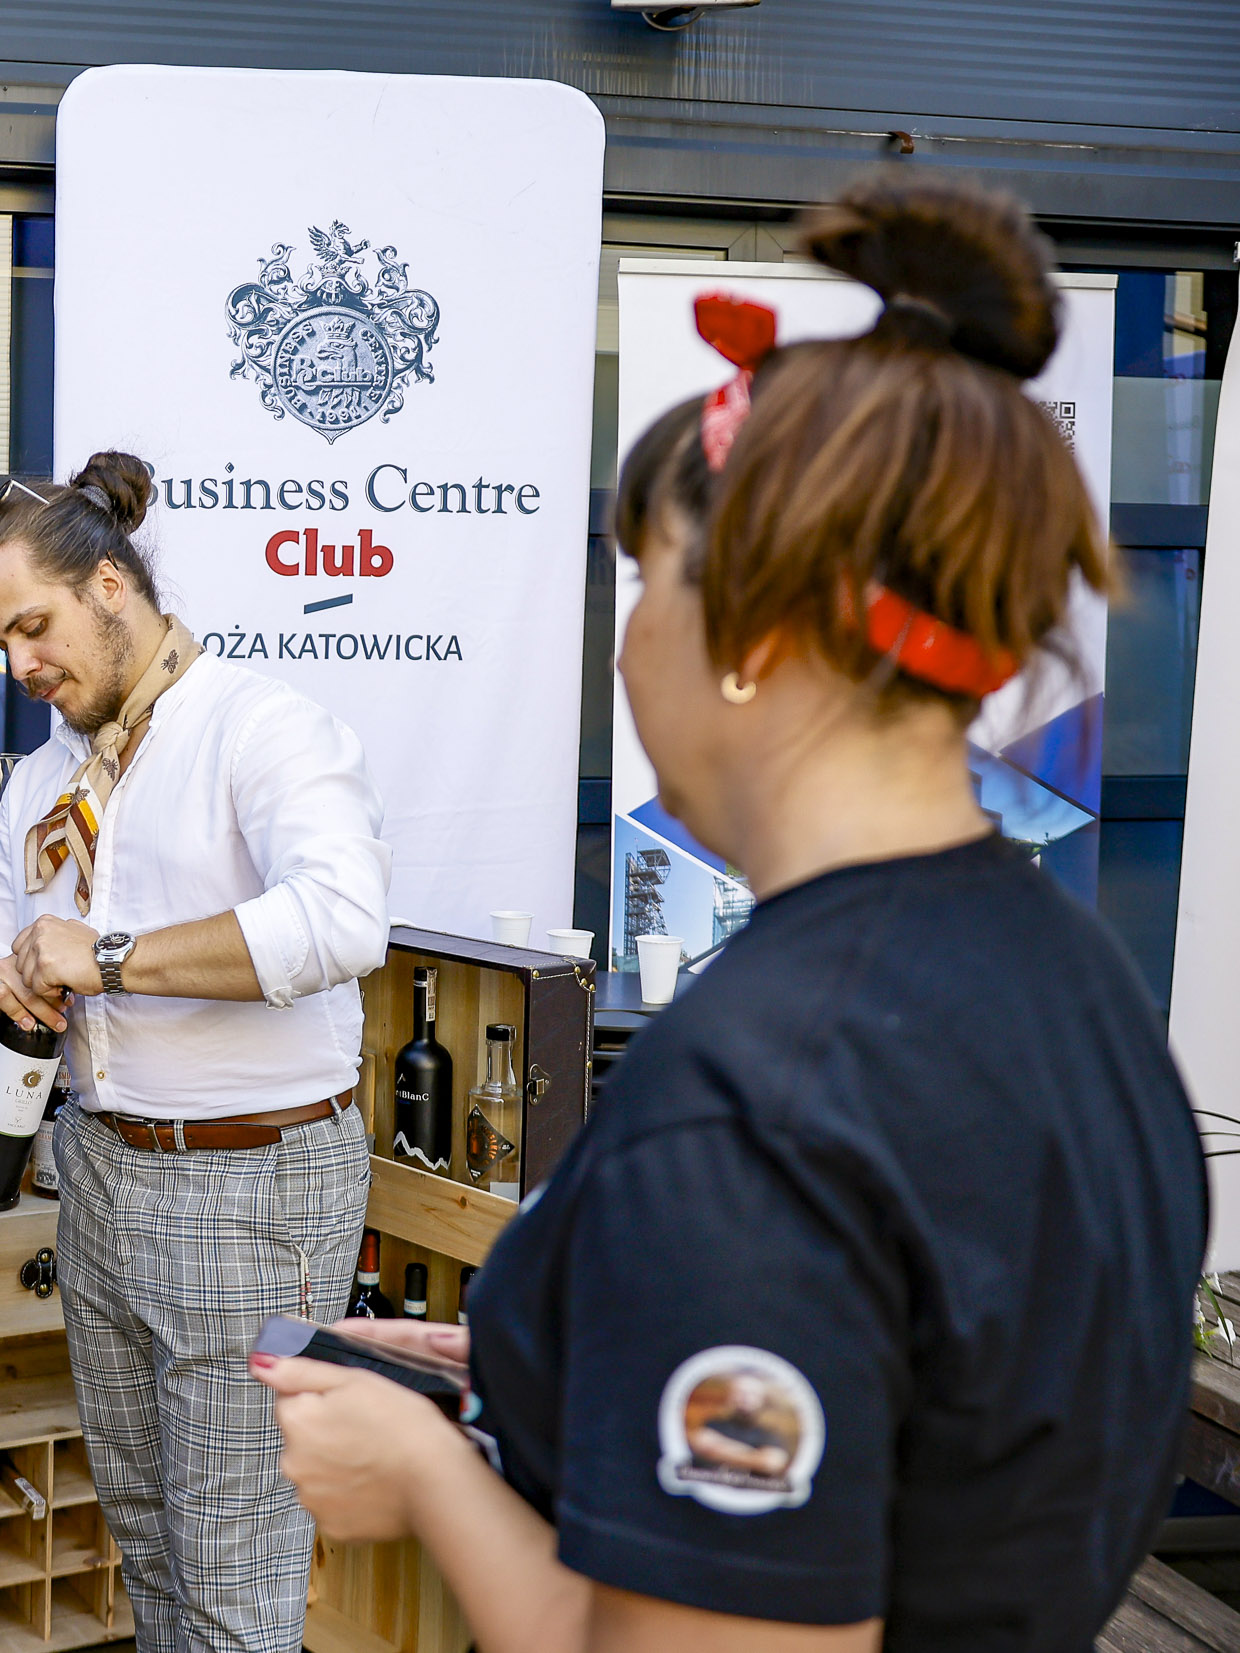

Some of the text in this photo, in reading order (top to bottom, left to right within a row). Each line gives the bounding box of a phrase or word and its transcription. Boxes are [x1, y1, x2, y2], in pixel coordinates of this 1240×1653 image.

[364, 463, 542, 515] Centre
[264, 527, 395, 578] Club
[191, 624, 464, 662] OŻA KATOWICKA
[6, 1085, 43, 1100] LUNA
